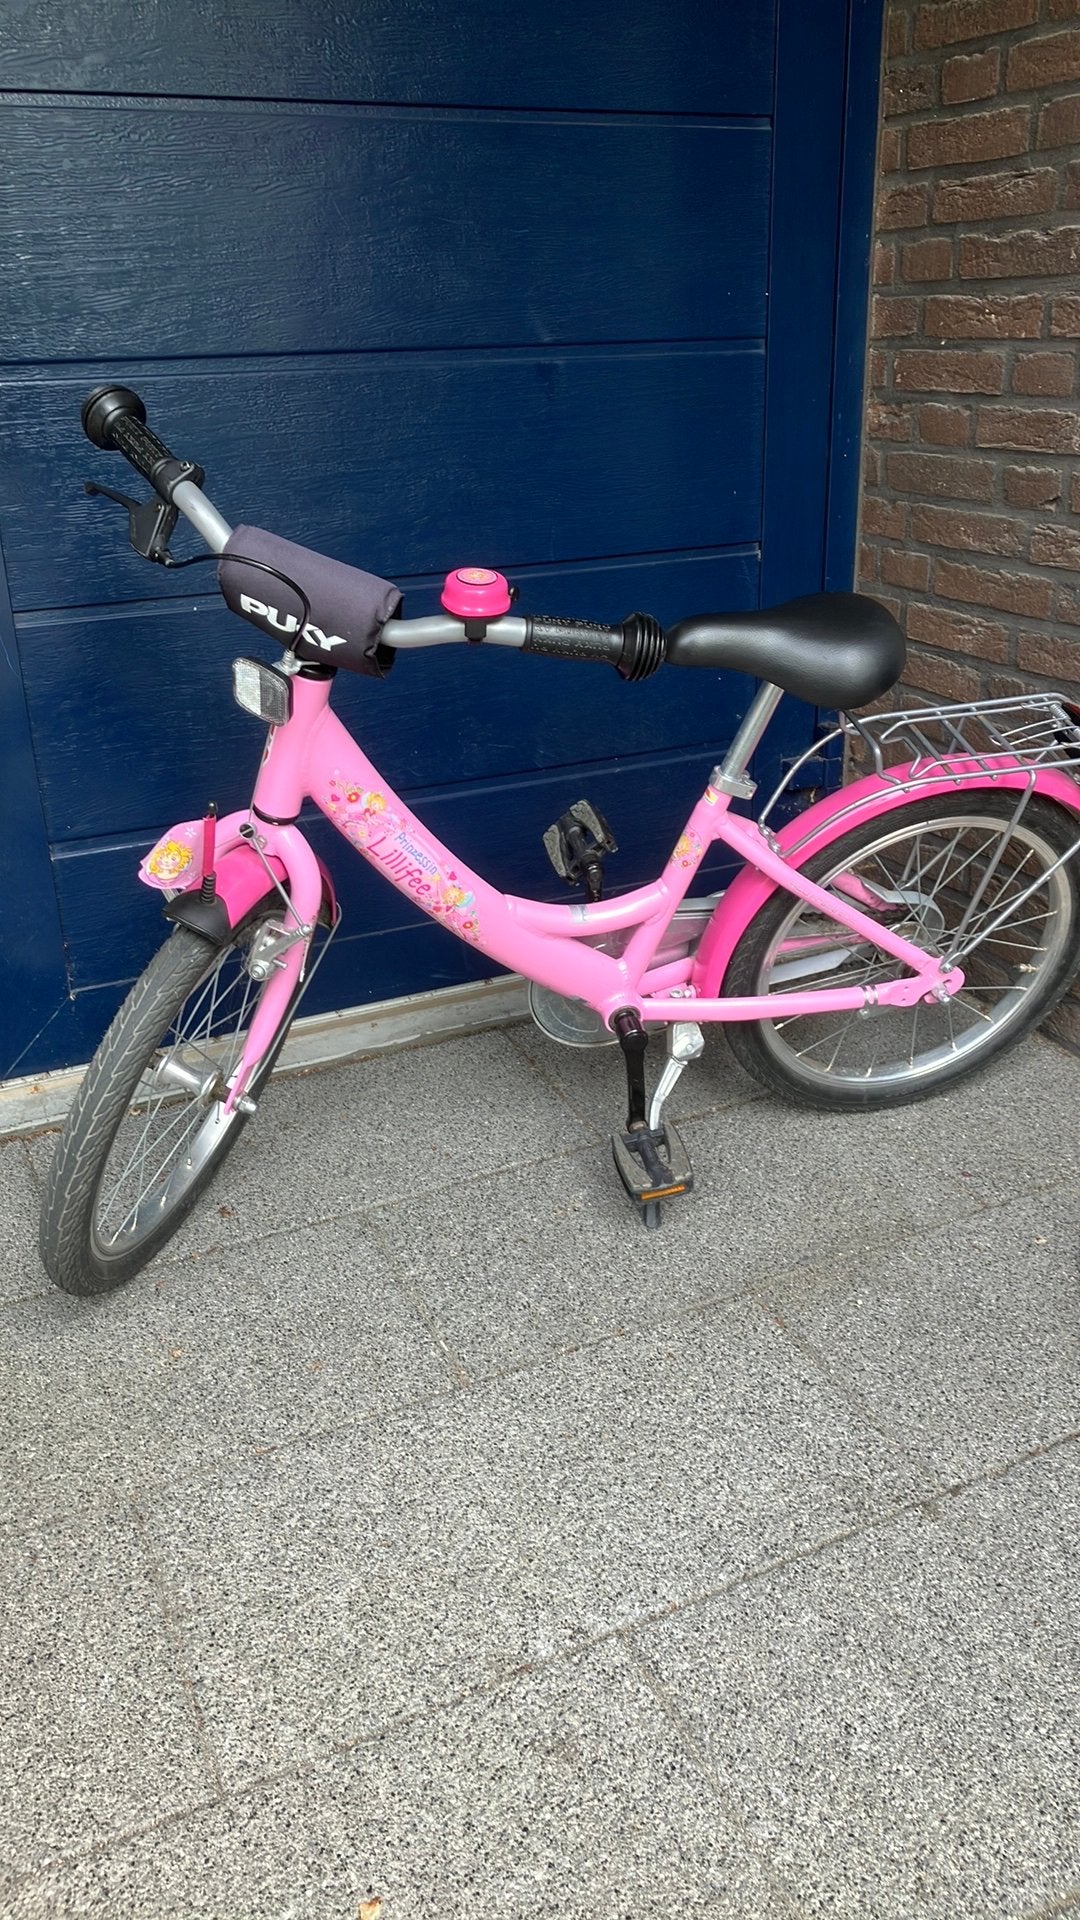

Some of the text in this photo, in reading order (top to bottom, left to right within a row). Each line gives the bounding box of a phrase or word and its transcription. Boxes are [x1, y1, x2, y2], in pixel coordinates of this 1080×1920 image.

[240, 593, 348, 652] PUKY
[366, 836, 432, 895] Lillifee
[395, 832, 438, 875] Prinzessin
